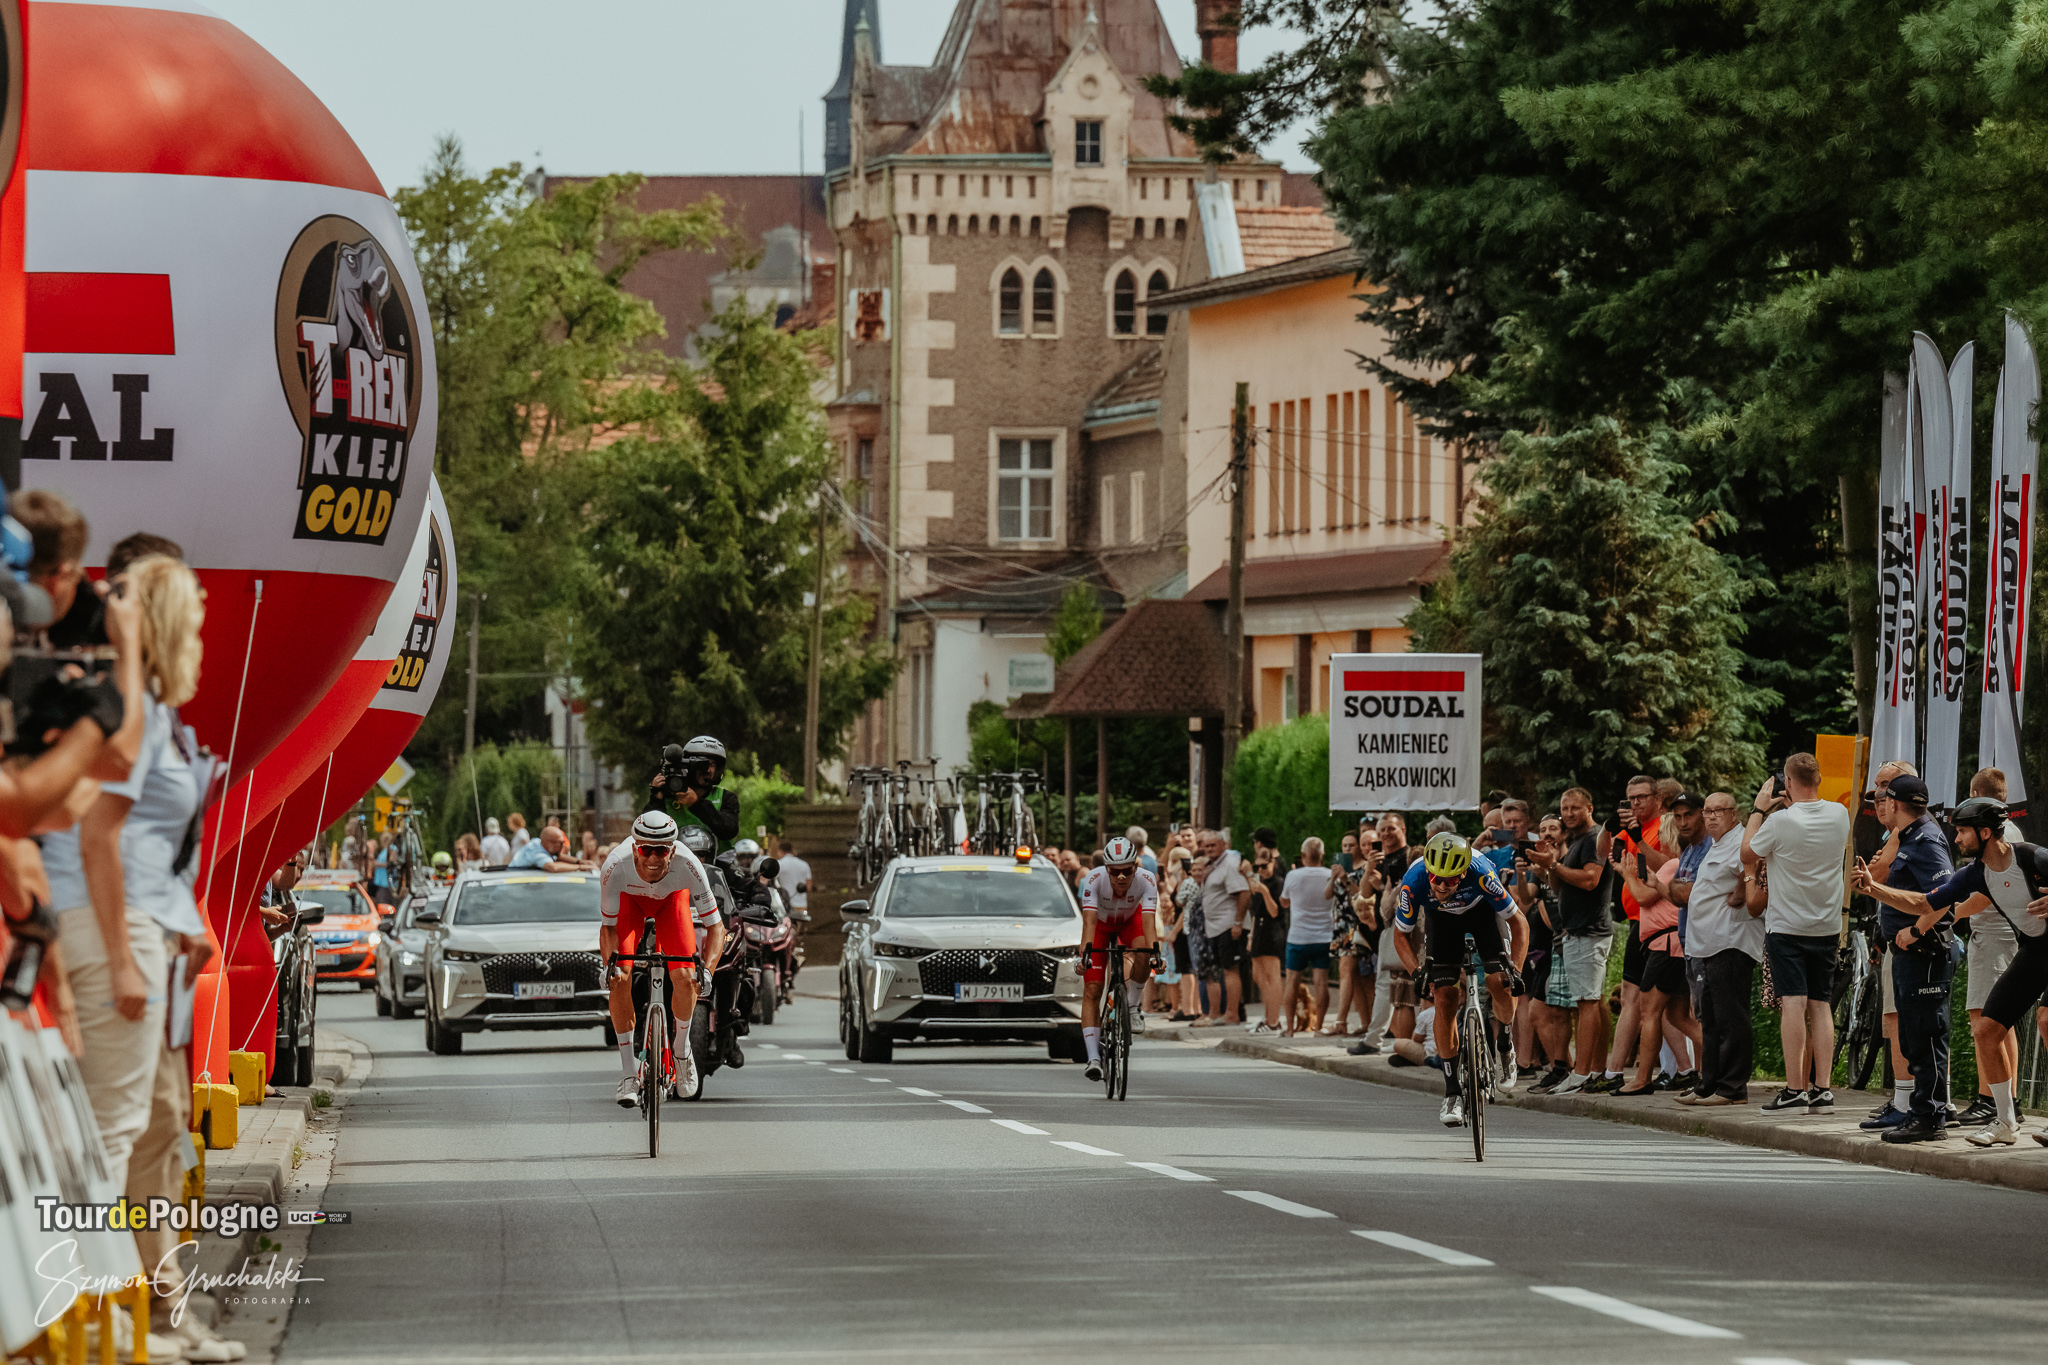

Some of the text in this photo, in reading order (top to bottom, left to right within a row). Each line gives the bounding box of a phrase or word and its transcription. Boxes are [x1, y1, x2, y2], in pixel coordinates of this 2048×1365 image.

[21, 373, 174, 461] AL
[311, 433, 404, 482] KLEJ
[305, 484, 392, 537] GOLD
[416, 572, 438, 620] EX
[386, 655, 425, 688] OLD
[1344, 695, 1464, 718] SOUDAL
[1358, 733, 1449, 754] KAMIENIEC
[1354, 767, 1456, 791] ZĄBKOWICKI
[602, 862, 618, 887] POLSKA
[685, 861, 703, 884] POLSKA
[1932, 869, 1951, 881] POLICJA
[1484, 876, 1504, 895] LOTTO
[1401, 890, 1410, 912] LOTTO
[521, 985, 535, 996] WJ
[963, 986, 1021, 998] WJ 7911M
[1918, 986, 1942, 995] POLICJA
